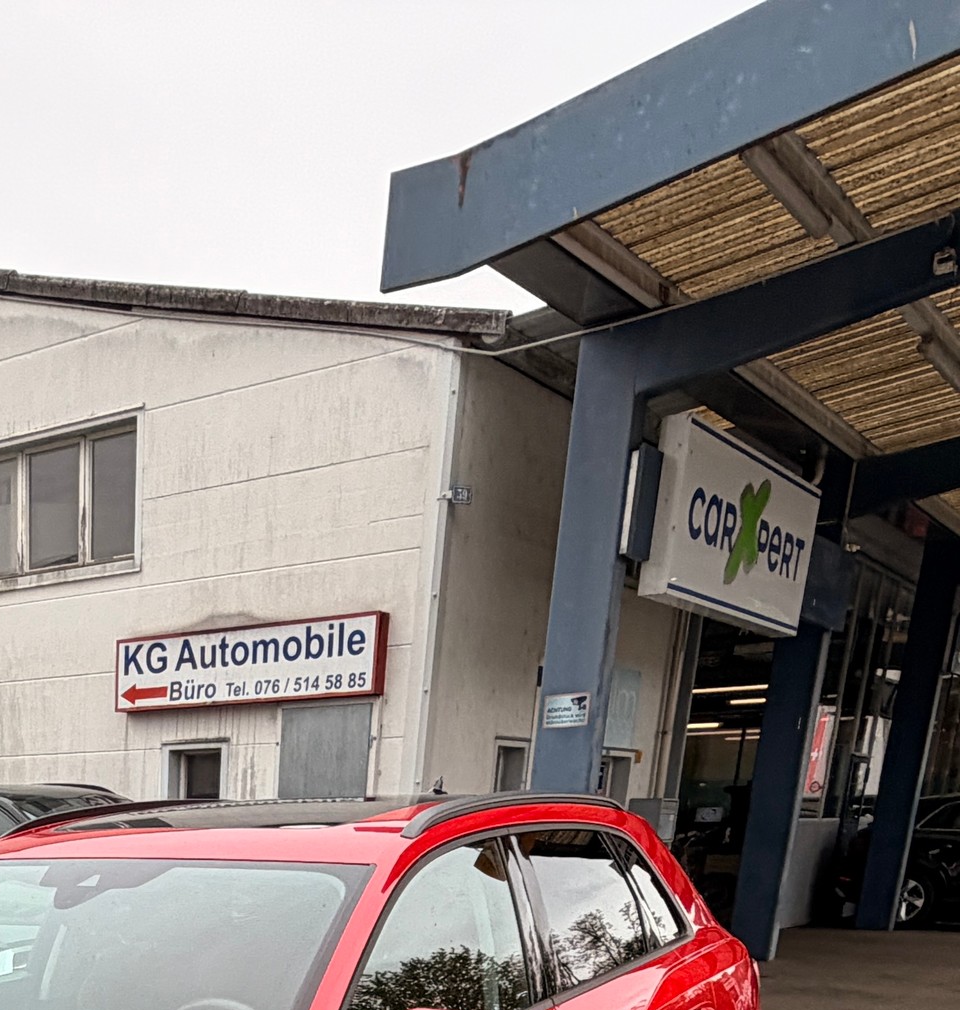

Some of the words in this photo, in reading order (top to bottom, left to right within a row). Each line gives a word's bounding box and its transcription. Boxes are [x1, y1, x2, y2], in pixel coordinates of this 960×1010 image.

[123, 642, 168, 676] KG
[174, 622, 367, 672] Automobile
[168, 680, 217, 702] Büro
[225, 682, 250, 698] Tel.
[254, 679, 281, 695] 076
[284, 677, 290, 694] /
[293, 675, 320, 693] 514
[325, 673, 343, 690] 58
[347, 671, 367, 689] 85
